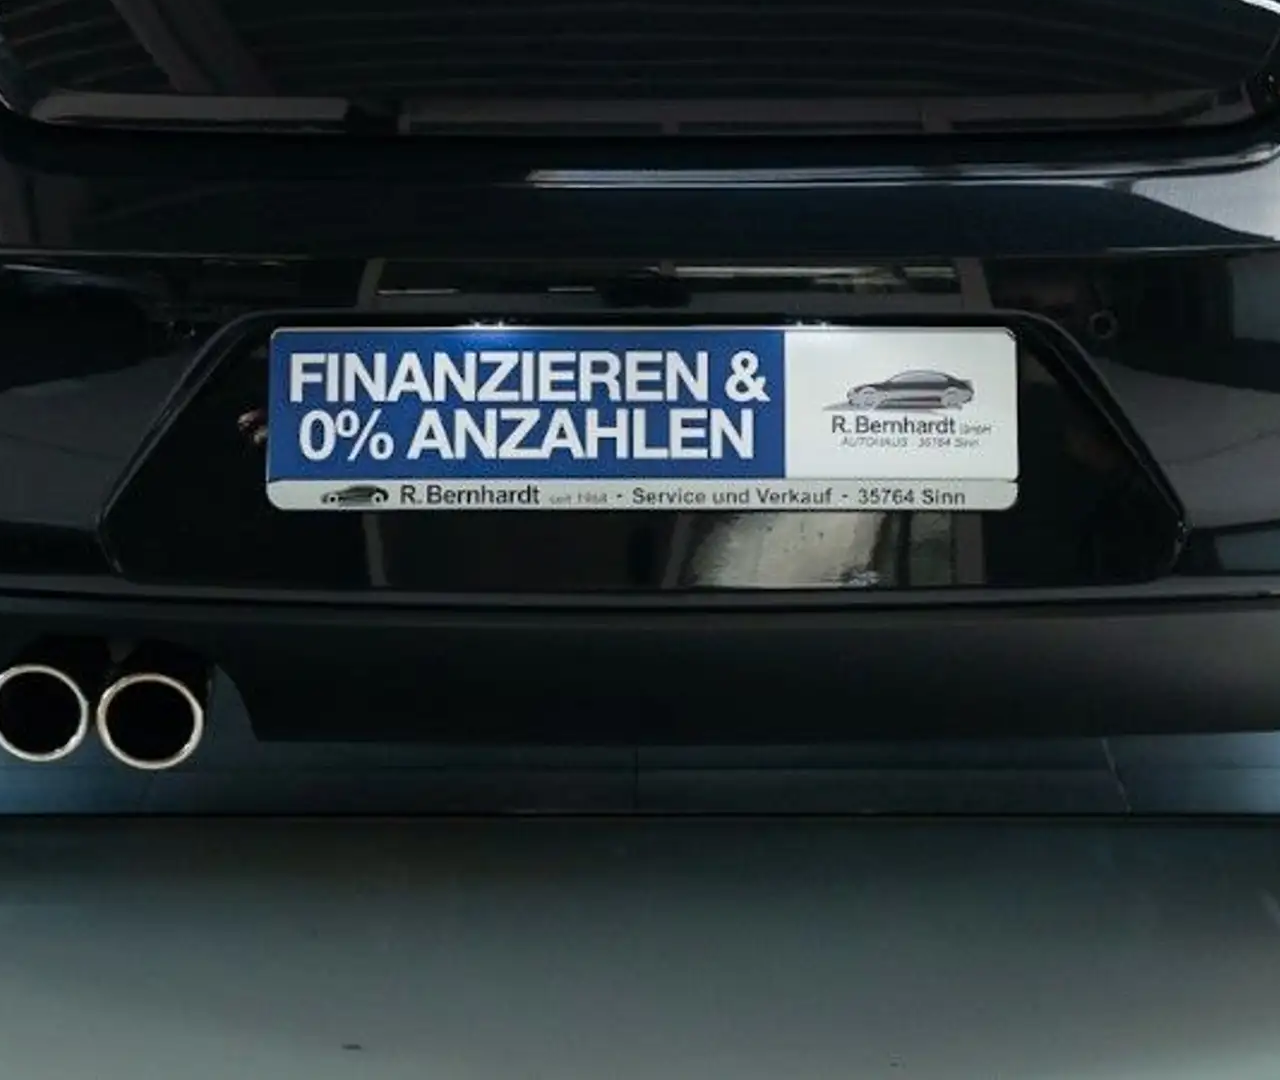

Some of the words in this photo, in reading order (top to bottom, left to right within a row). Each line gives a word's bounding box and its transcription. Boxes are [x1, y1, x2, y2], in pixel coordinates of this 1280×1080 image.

[289, 352, 709, 402] FINANZIEREN
[725, 351, 770, 402] &
[299, 408, 394, 461] 0%
[406, 408, 754, 459] ANZAHLEN
[831, 415, 852, 434] R.
[855, 415, 956, 434] Bernhardt
[400, 484, 420, 504] R.
[427, 484, 540, 504] Bernhardt
[632, 488, 706, 505] Service
[712, 487, 750, 505] und
[756, 487, 832, 505] Verkauf
[858, 488, 914, 505] 35764
[922, 488, 966, 505] Sinn
